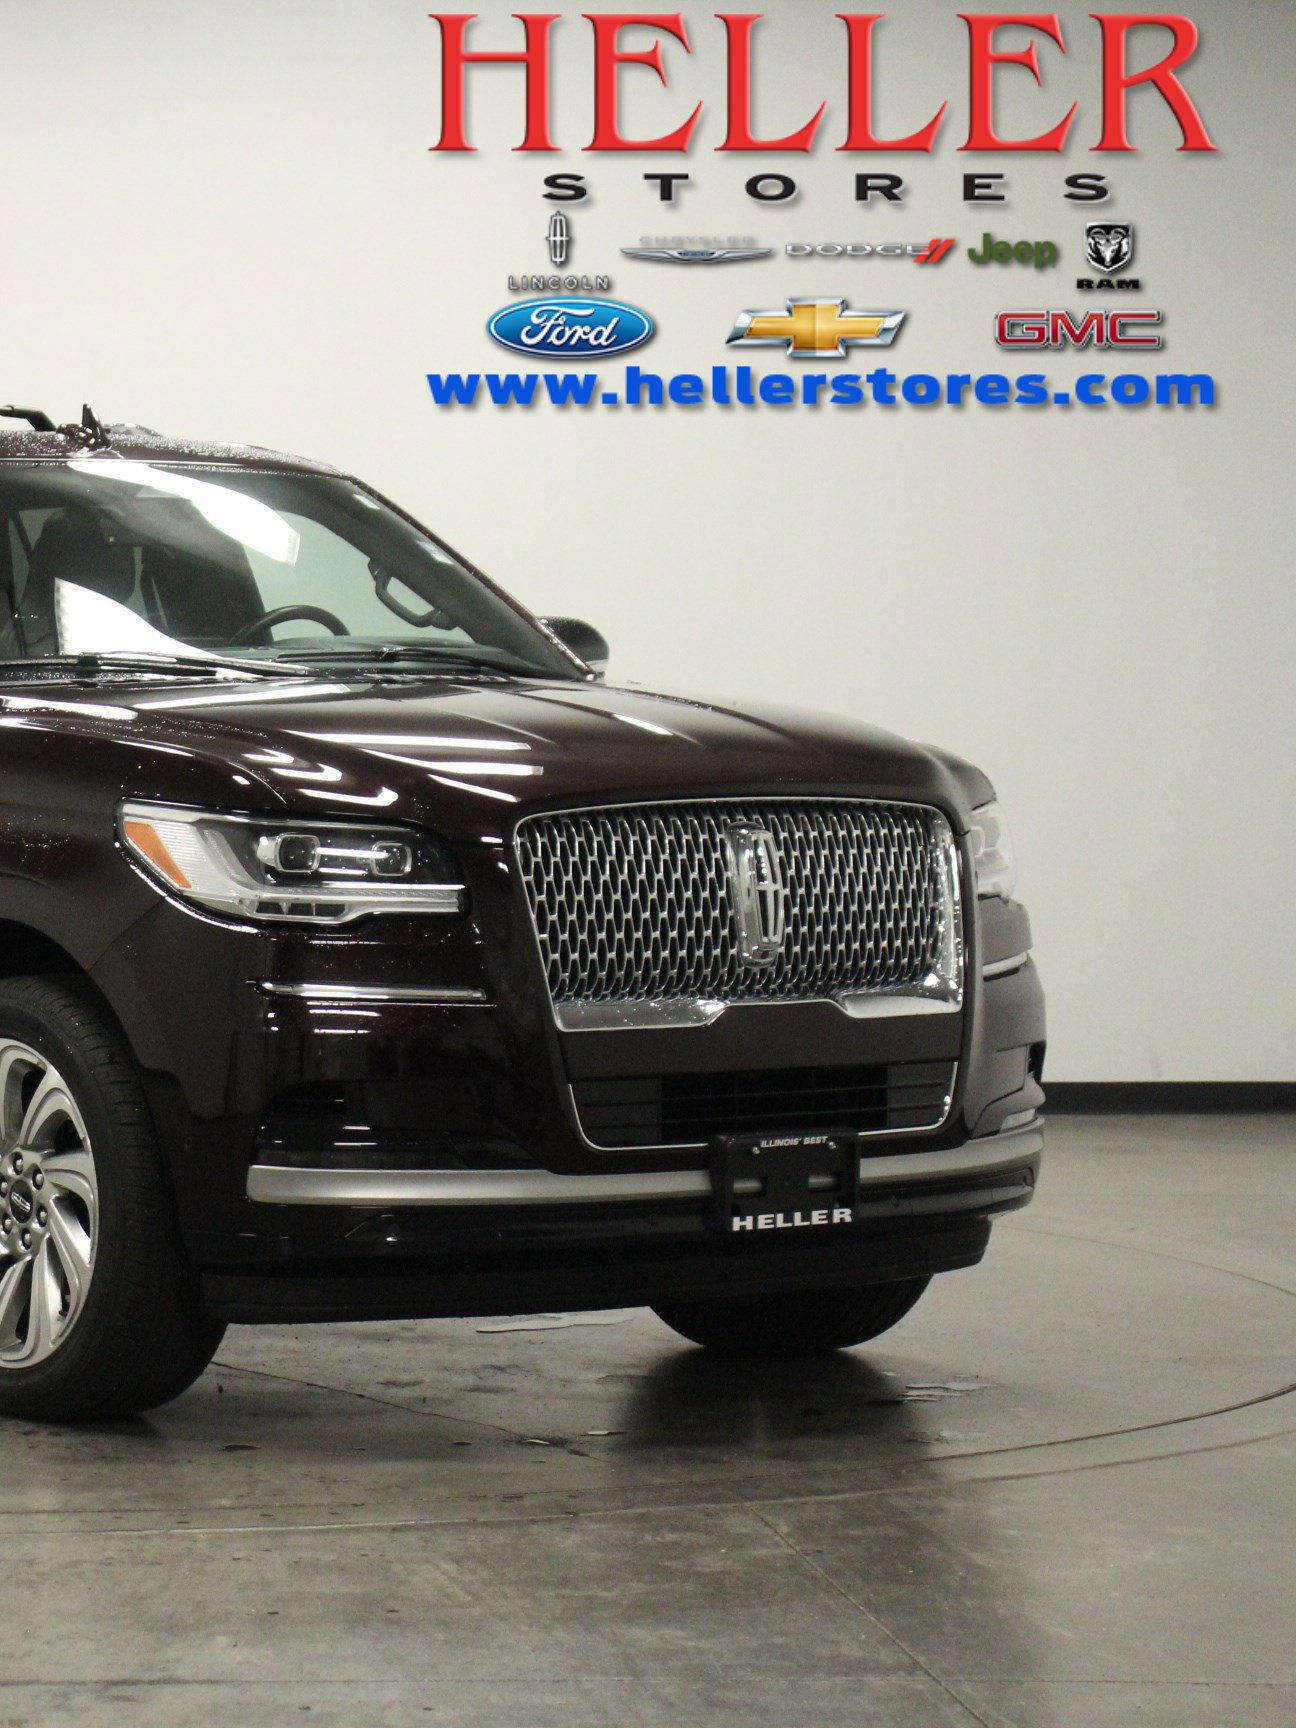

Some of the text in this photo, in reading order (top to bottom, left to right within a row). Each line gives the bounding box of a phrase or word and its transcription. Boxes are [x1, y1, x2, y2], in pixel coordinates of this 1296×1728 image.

[761, 1136, 828, 1147] ILLINOIS' BEST
[733, 1208, 852, 1231] HELLER
